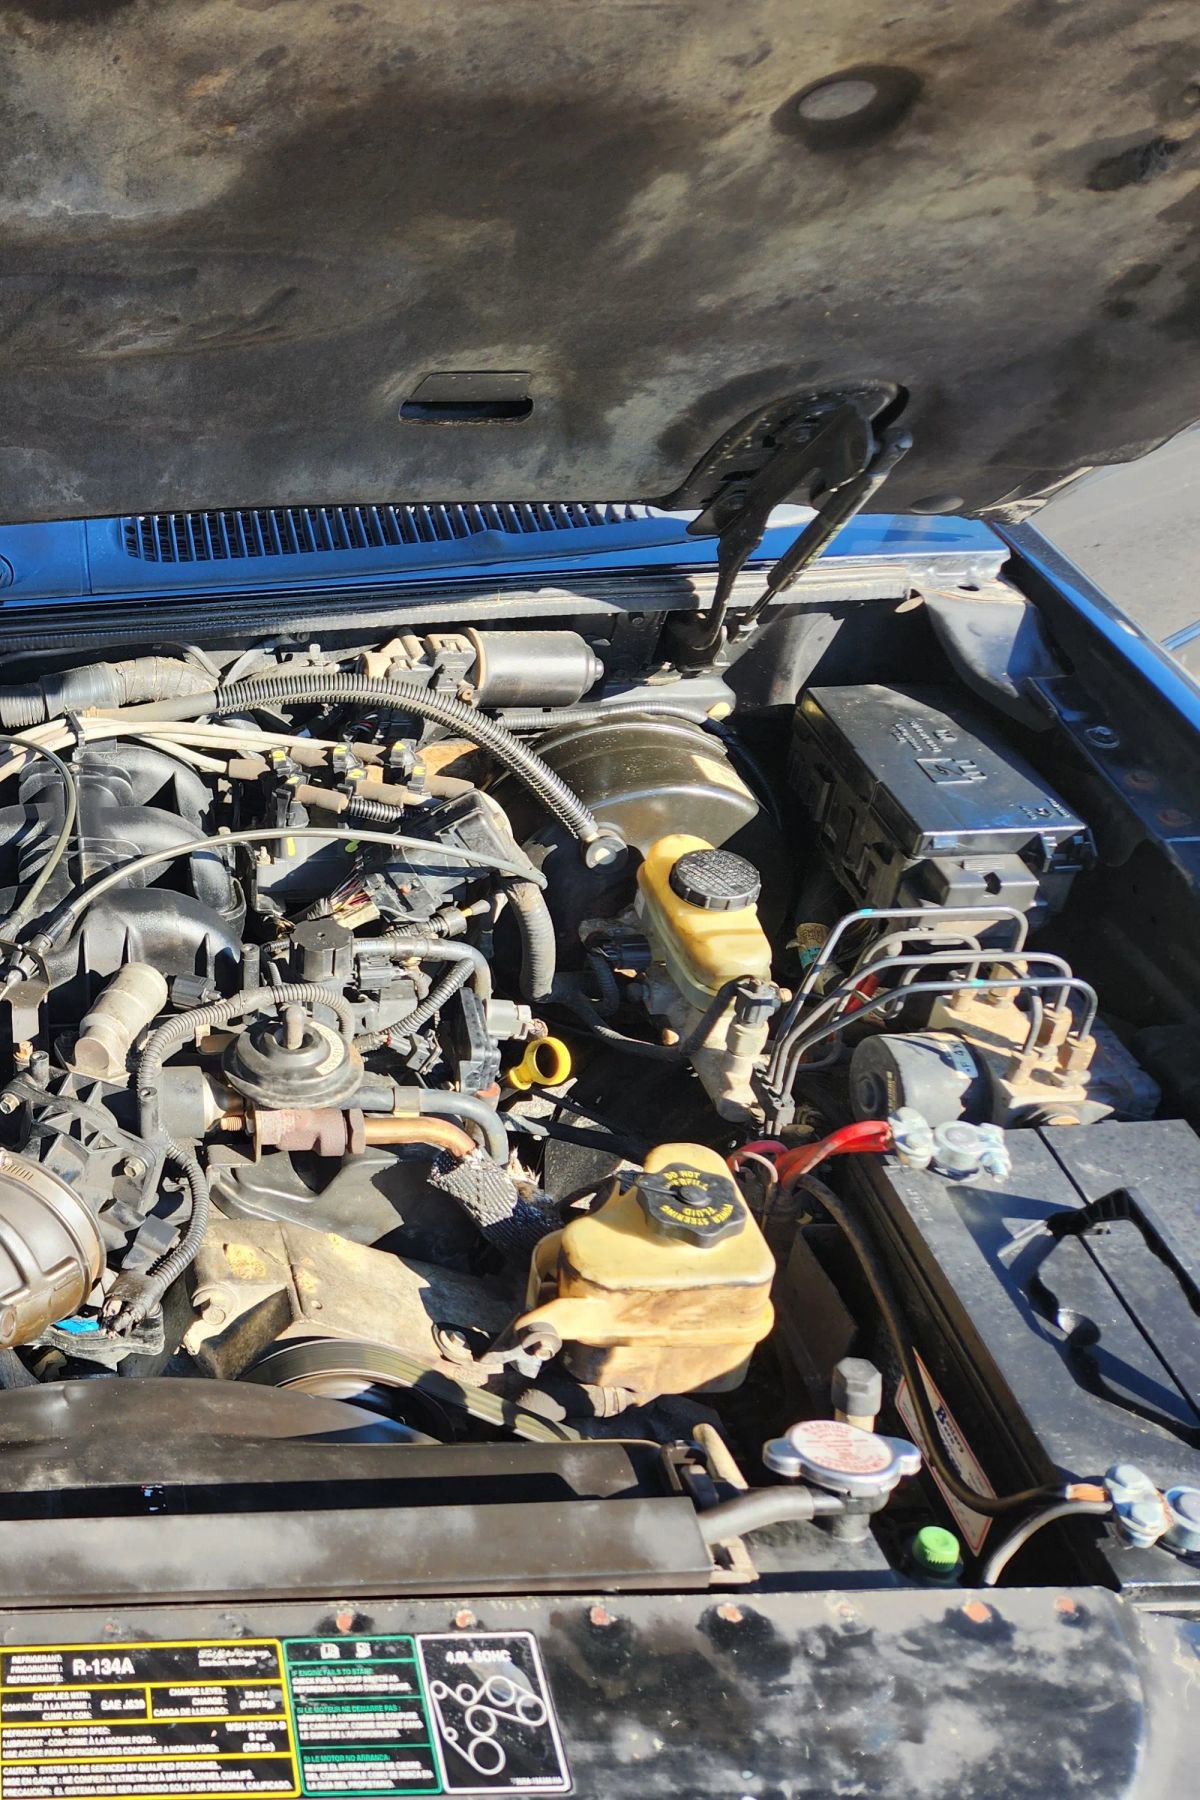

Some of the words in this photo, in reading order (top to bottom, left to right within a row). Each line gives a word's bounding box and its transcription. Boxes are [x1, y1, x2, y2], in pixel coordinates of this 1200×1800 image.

[679, 1170, 701, 1179] NOT
[682, 1206, 716, 1218] FLUID
[472, 1649, 512, 1664] SOHC
[72, 1657, 135, 1675] R-134A
[169, 1688, 200, 1696] CHARGE
[101, 1699, 122, 1710] SAE
[153, 1708, 180, 1717] CARGA
[68, 1727, 88, 1736] FORD
[3, 1766, 37, 1775] CAUTION:
